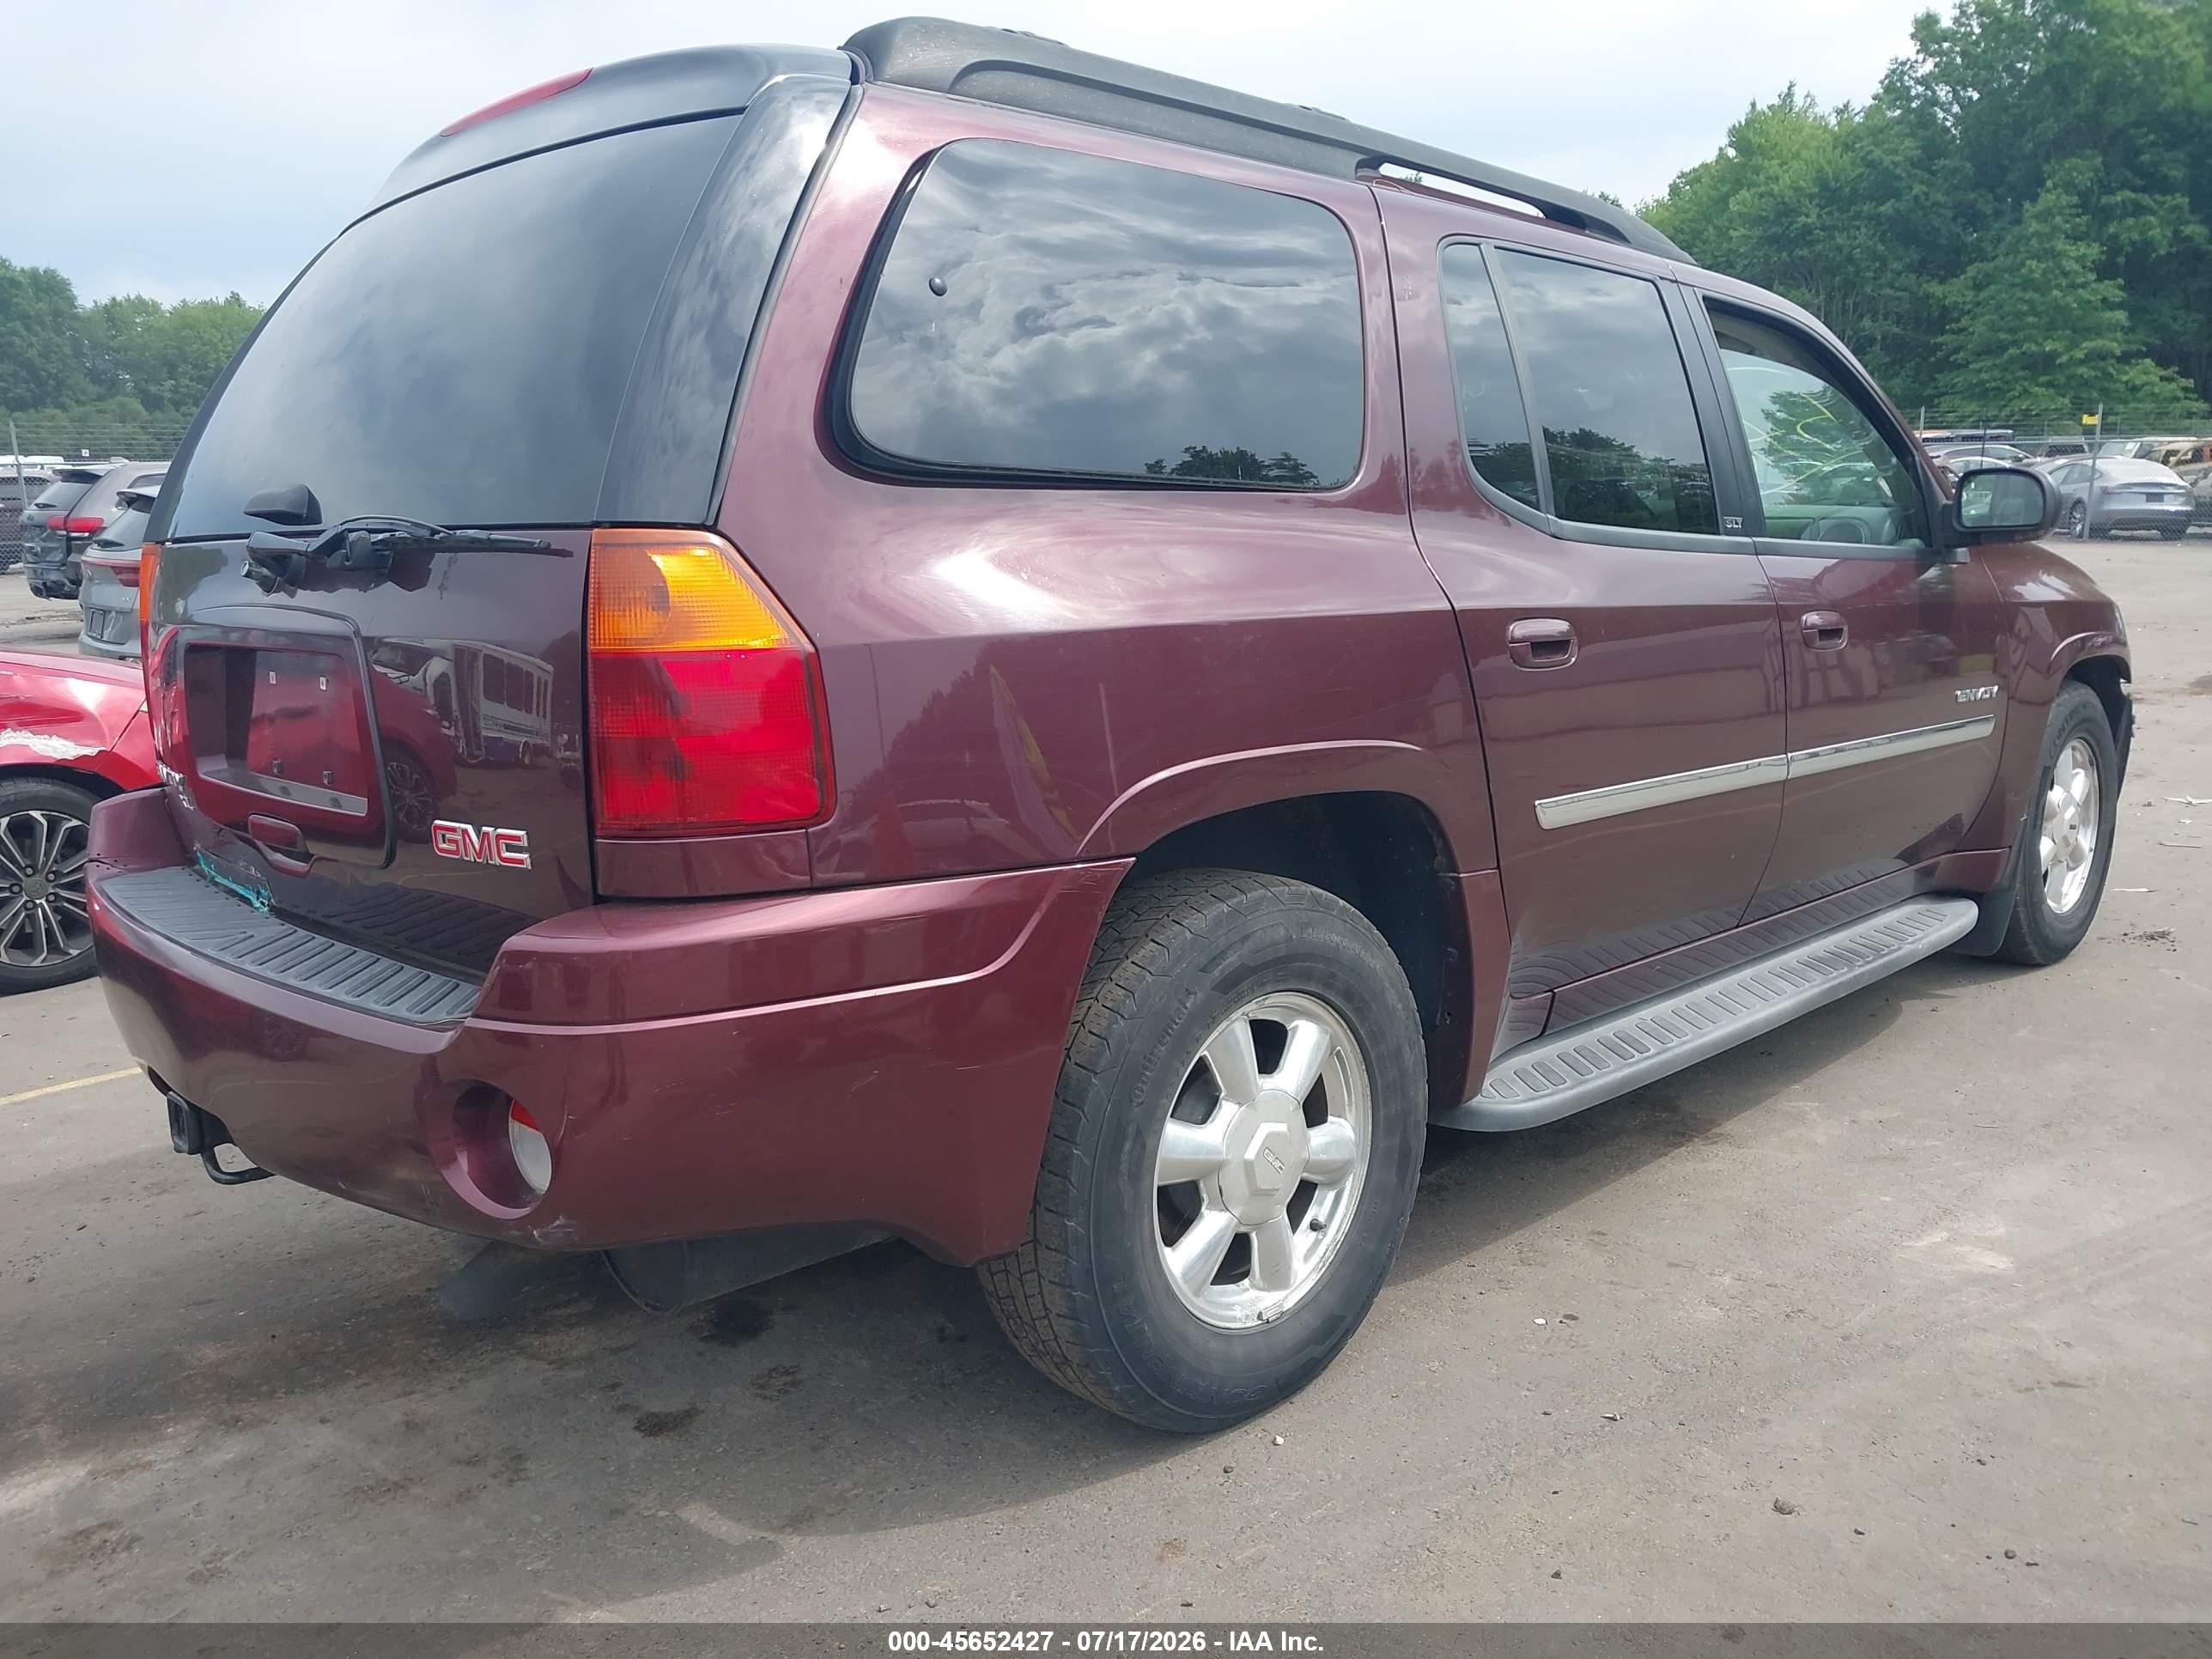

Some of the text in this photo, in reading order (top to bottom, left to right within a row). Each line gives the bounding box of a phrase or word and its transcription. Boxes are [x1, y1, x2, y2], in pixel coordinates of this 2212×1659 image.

[1724, 516, 1743, 528] SLT
[1954, 685, 1999, 702] ENVOY
[432, 819, 532, 869] GMC
[1263, 1146, 1285, 1175] GMC
